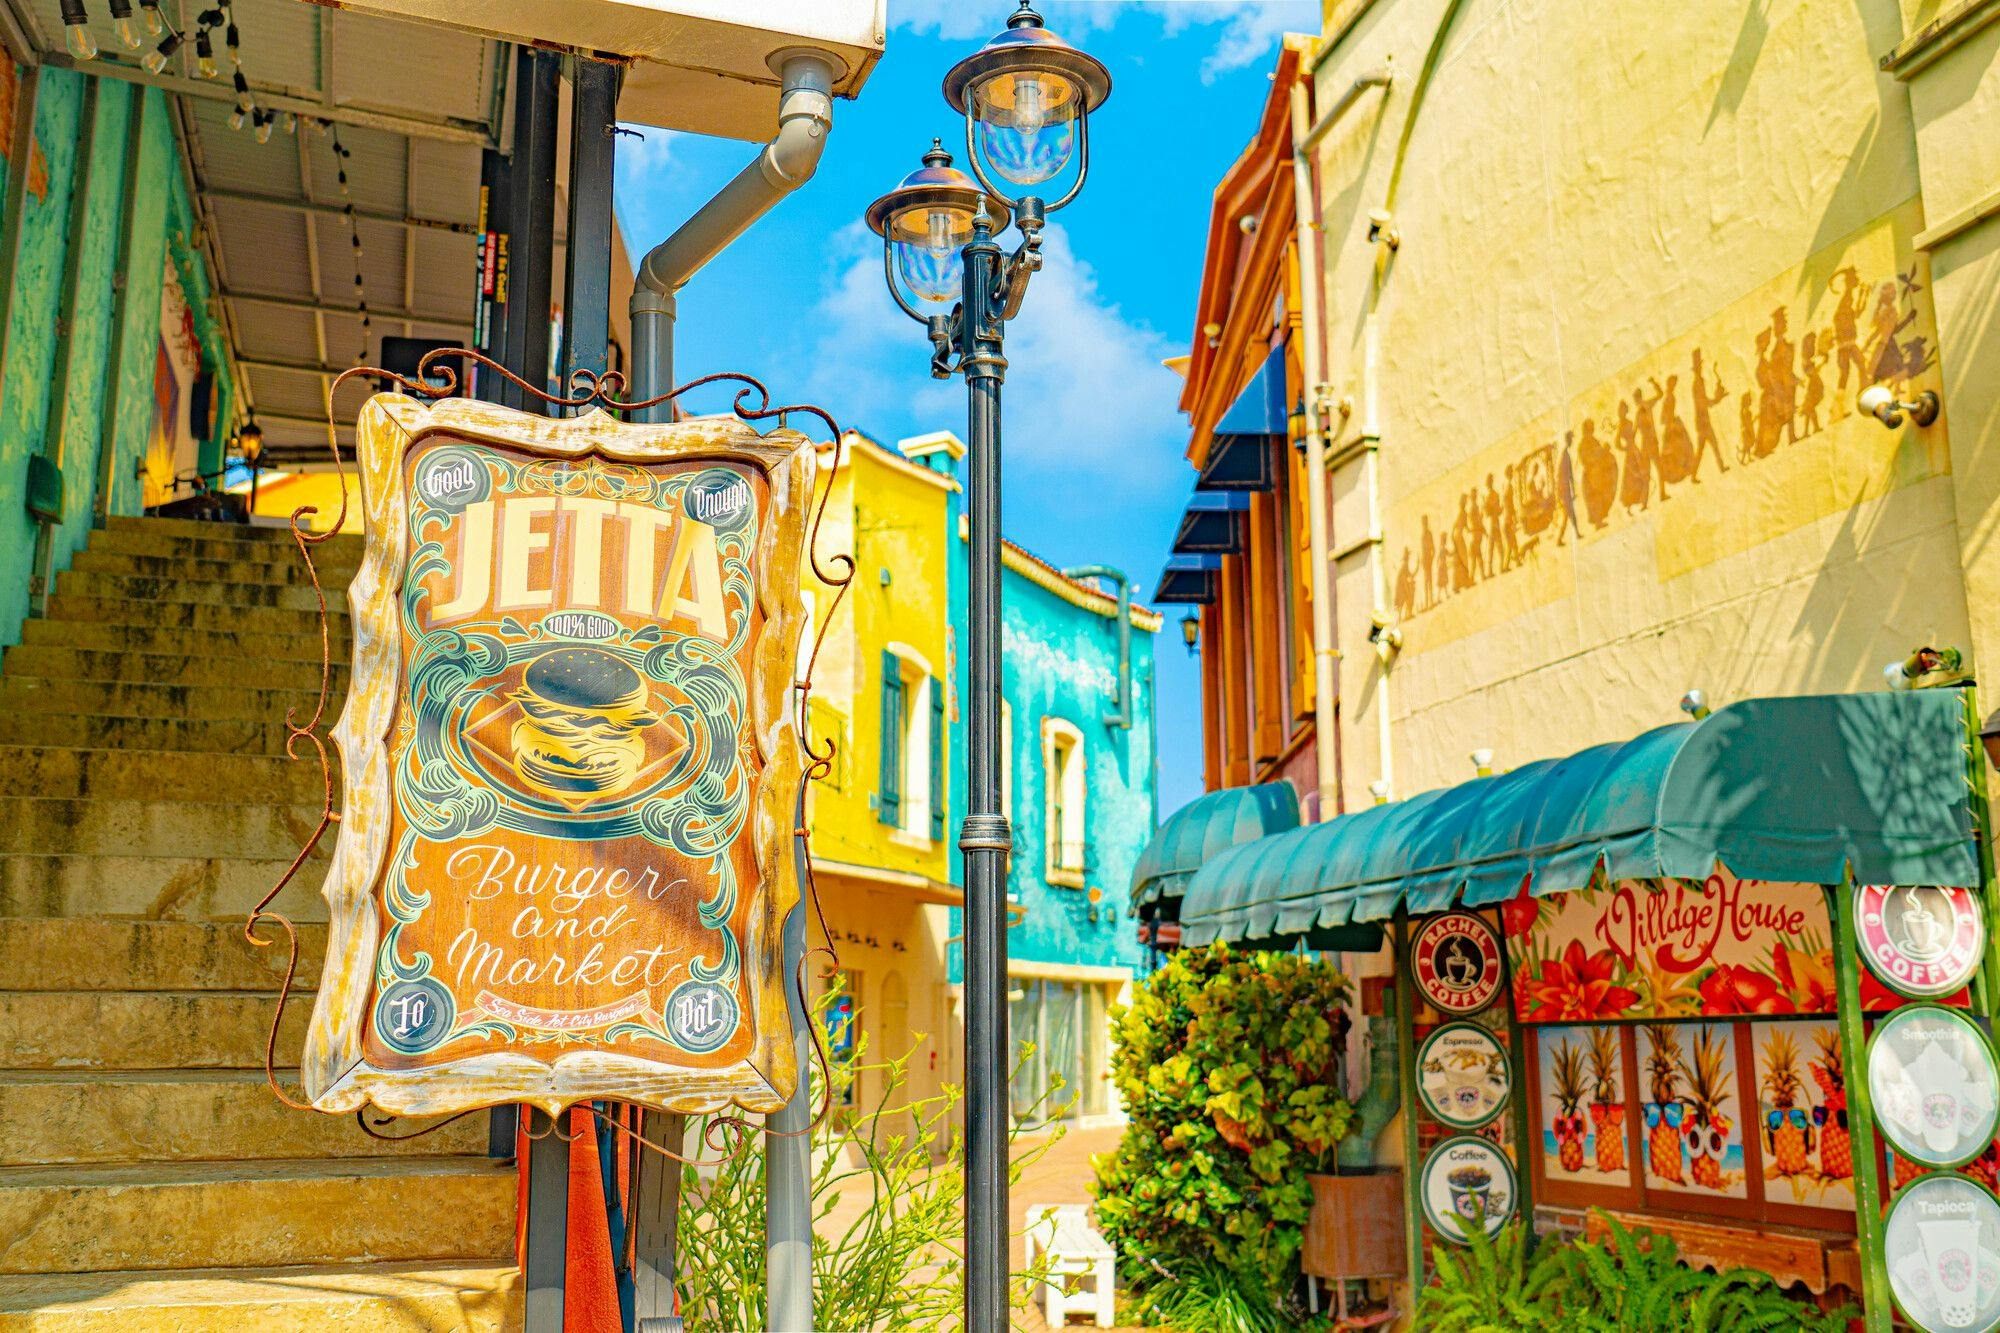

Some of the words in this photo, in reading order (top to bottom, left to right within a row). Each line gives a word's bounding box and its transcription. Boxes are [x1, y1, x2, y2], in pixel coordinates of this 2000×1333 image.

[423, 457, 476, 500] Good
[430, 497, 728, 640] JETTA
[548, 615, 585, 637] 100%
[587, 615, 616, 638] GOOD
[446, 844, 688, 913] Burger
[1426, 919, 1487, 946] RACHEL
[1595, 887, 1713, 973] Village
[447, 928, 684, 987] Market
[1877, 943, 1969, 984] COFFEE
[1427, 978, 1494, 1007] COFFEE
[1443, 1037, 1483, 1046] Espresso
[1902, 1028, 1959, 1041] Smoothie
[1450, 1150, 1487, 1160] Coffee
[1918, 1200, 1975, 1216] Tapioca
